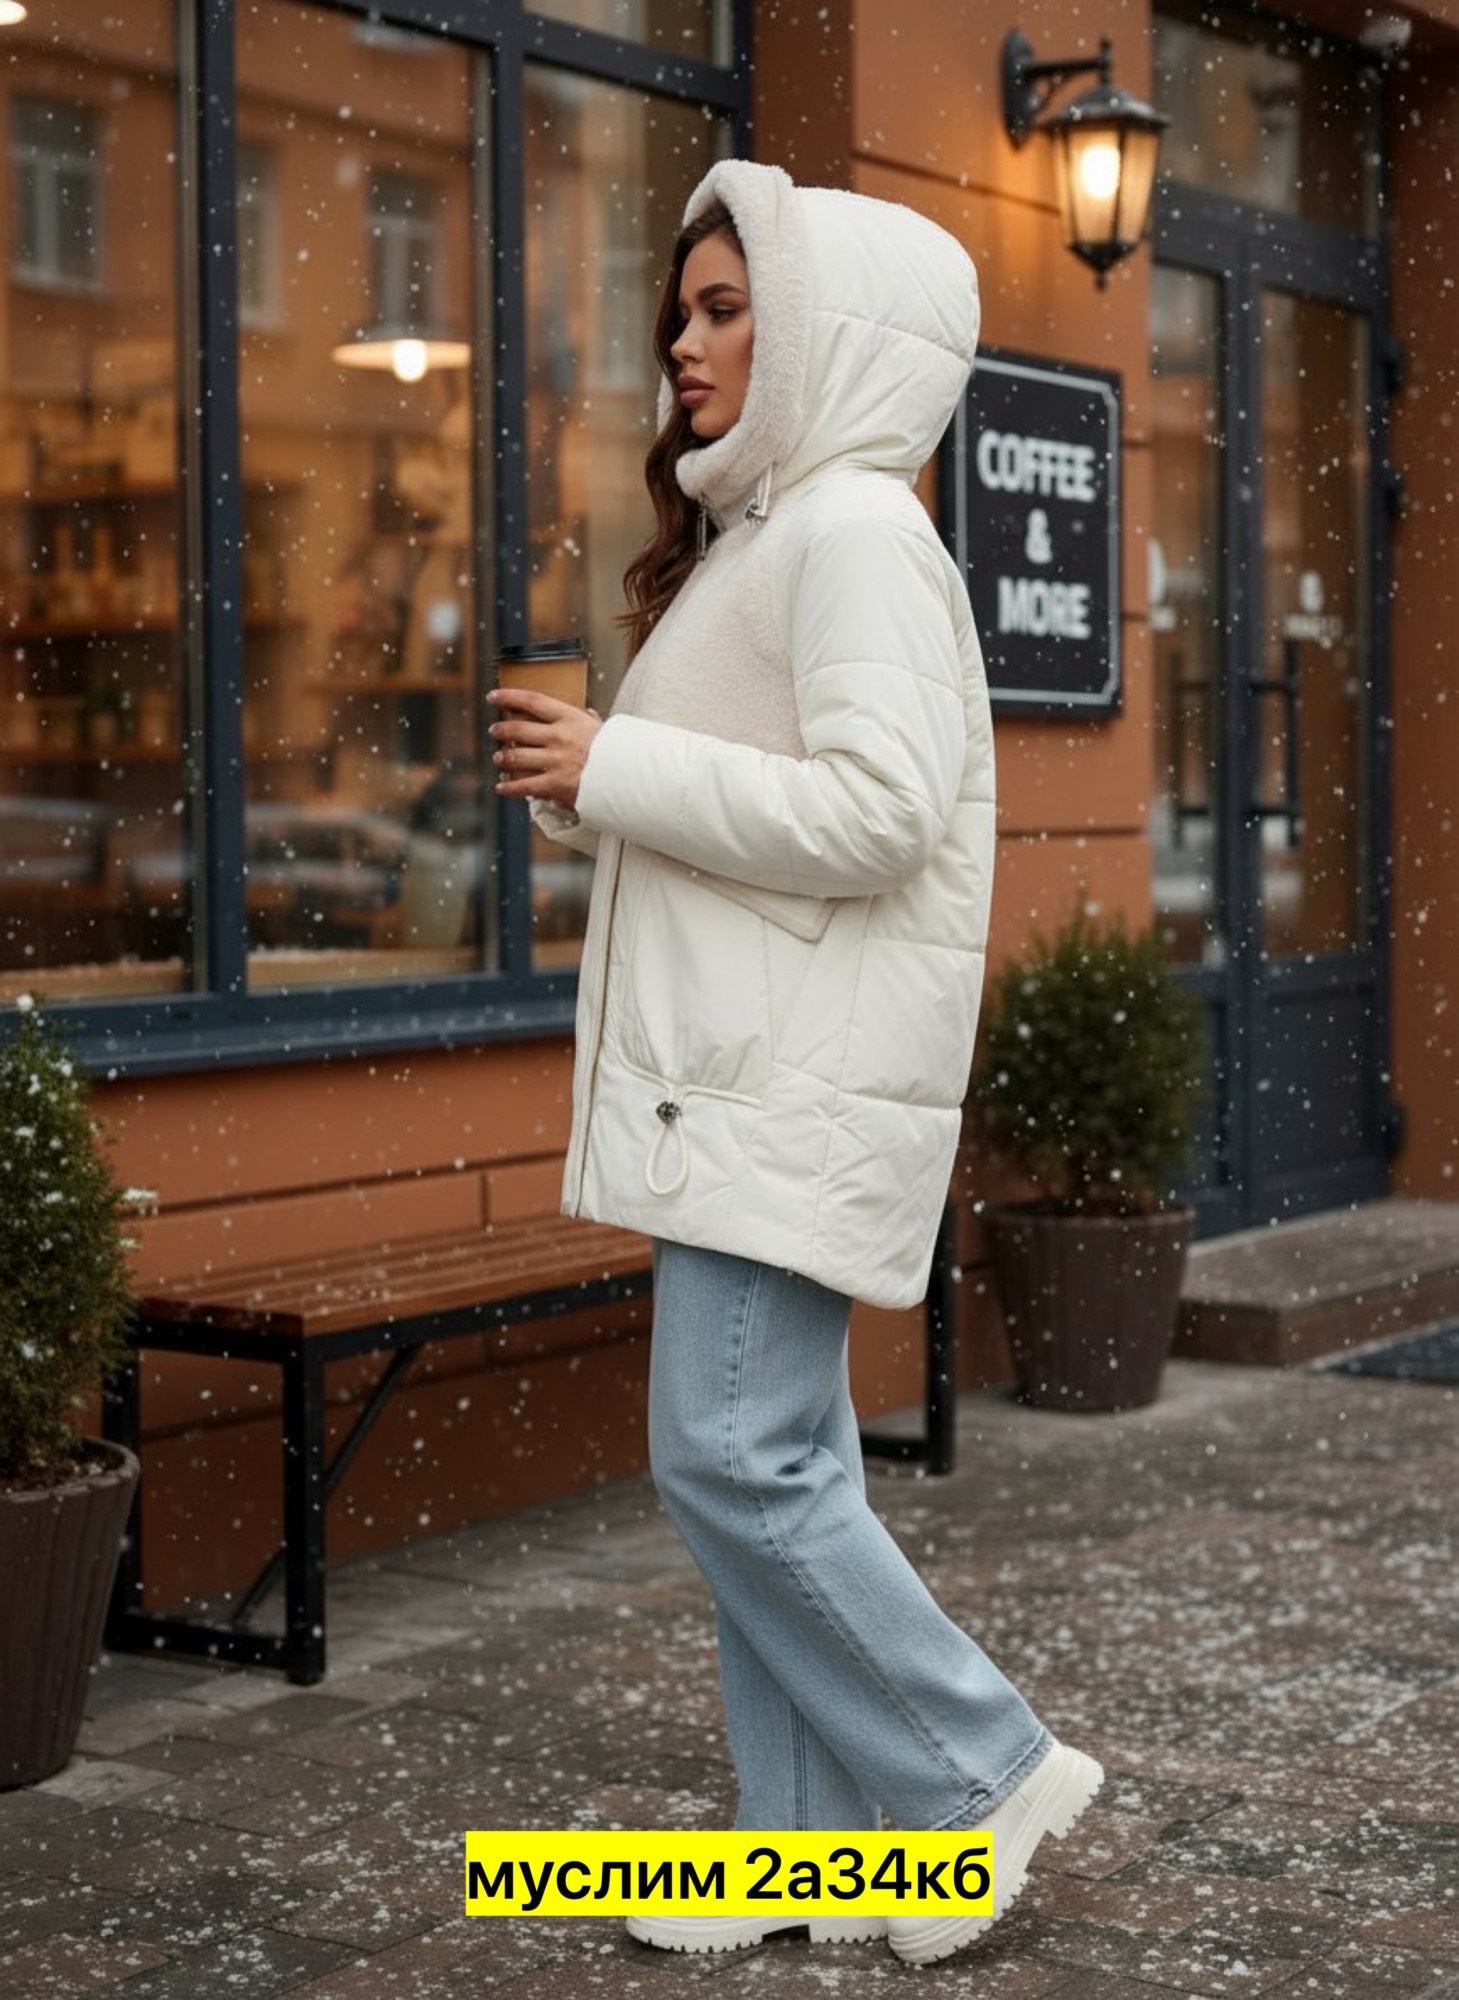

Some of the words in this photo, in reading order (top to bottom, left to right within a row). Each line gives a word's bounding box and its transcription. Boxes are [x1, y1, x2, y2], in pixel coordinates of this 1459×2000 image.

[977, 430, 1096, 502] COFFEE
[1025, 509, 1052, 564] &
[997, 577, 1091, 639] MORE
